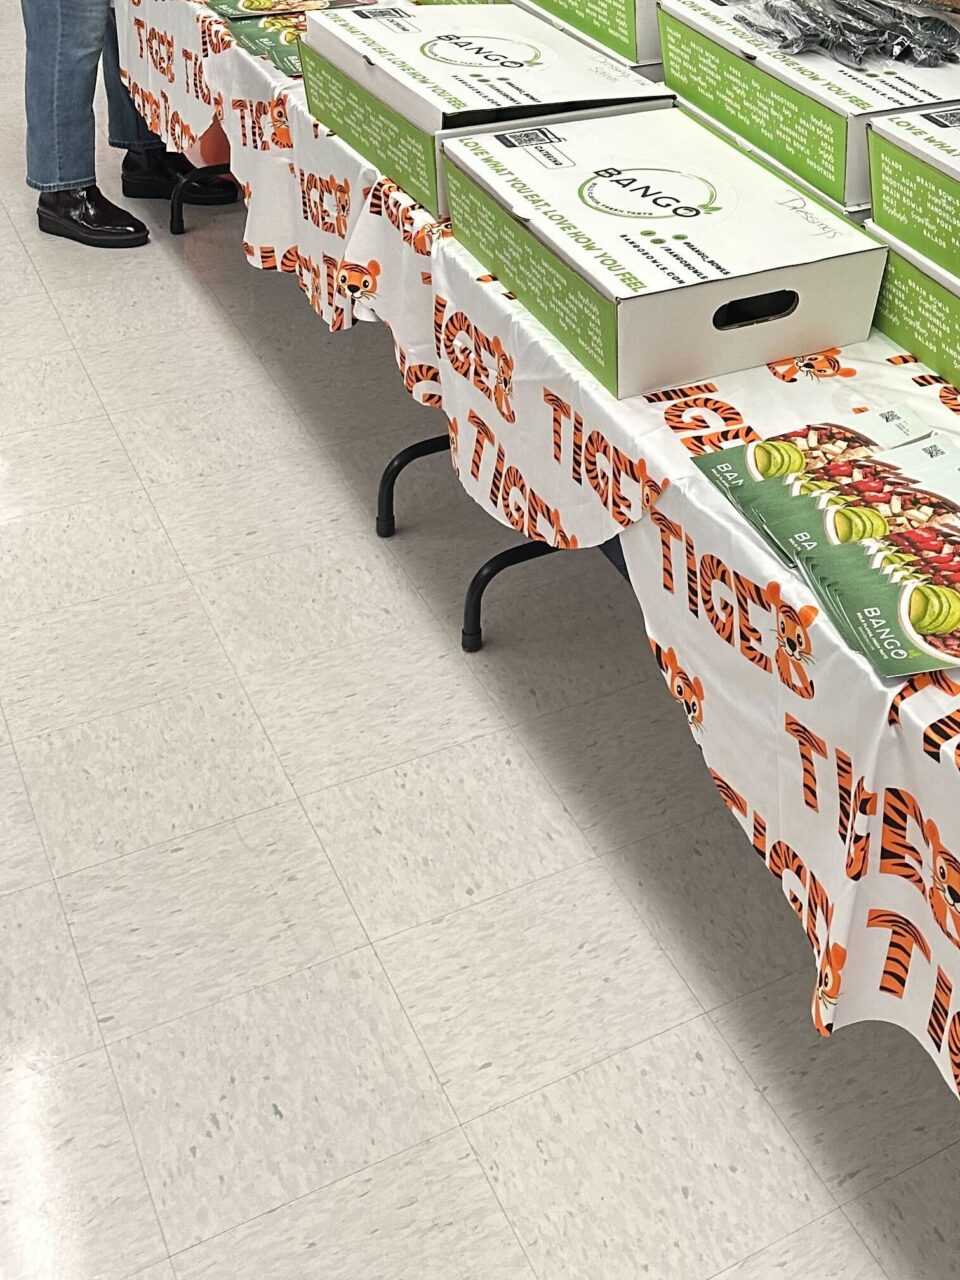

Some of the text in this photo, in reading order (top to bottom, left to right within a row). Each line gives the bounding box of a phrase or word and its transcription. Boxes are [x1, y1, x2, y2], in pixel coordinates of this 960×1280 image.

[133, 16, 175, 84] TIGER
[435, 34, 528, 68] BANGO
[887, 116, 925, 139] LOVE
[532, 145, 565, 166] CATERING
[881, 152, 902, 171] SALADS
[916, 175, 935, 192] GRAIN
[938, 188, 959, 207] BOWLS
[457, 137, 650, 292] LOVE WHAT YOU EAT, LOVE HOW YOU FEEL
[592, 167, 705, 219] BANGO
[617, 233, 686, 285] BANGOBOWLS.COM
[433, 294, 516, 424] IGER
[650, 506, 820, 701] TIGER
[863, 606, 908, 659] BANGO
